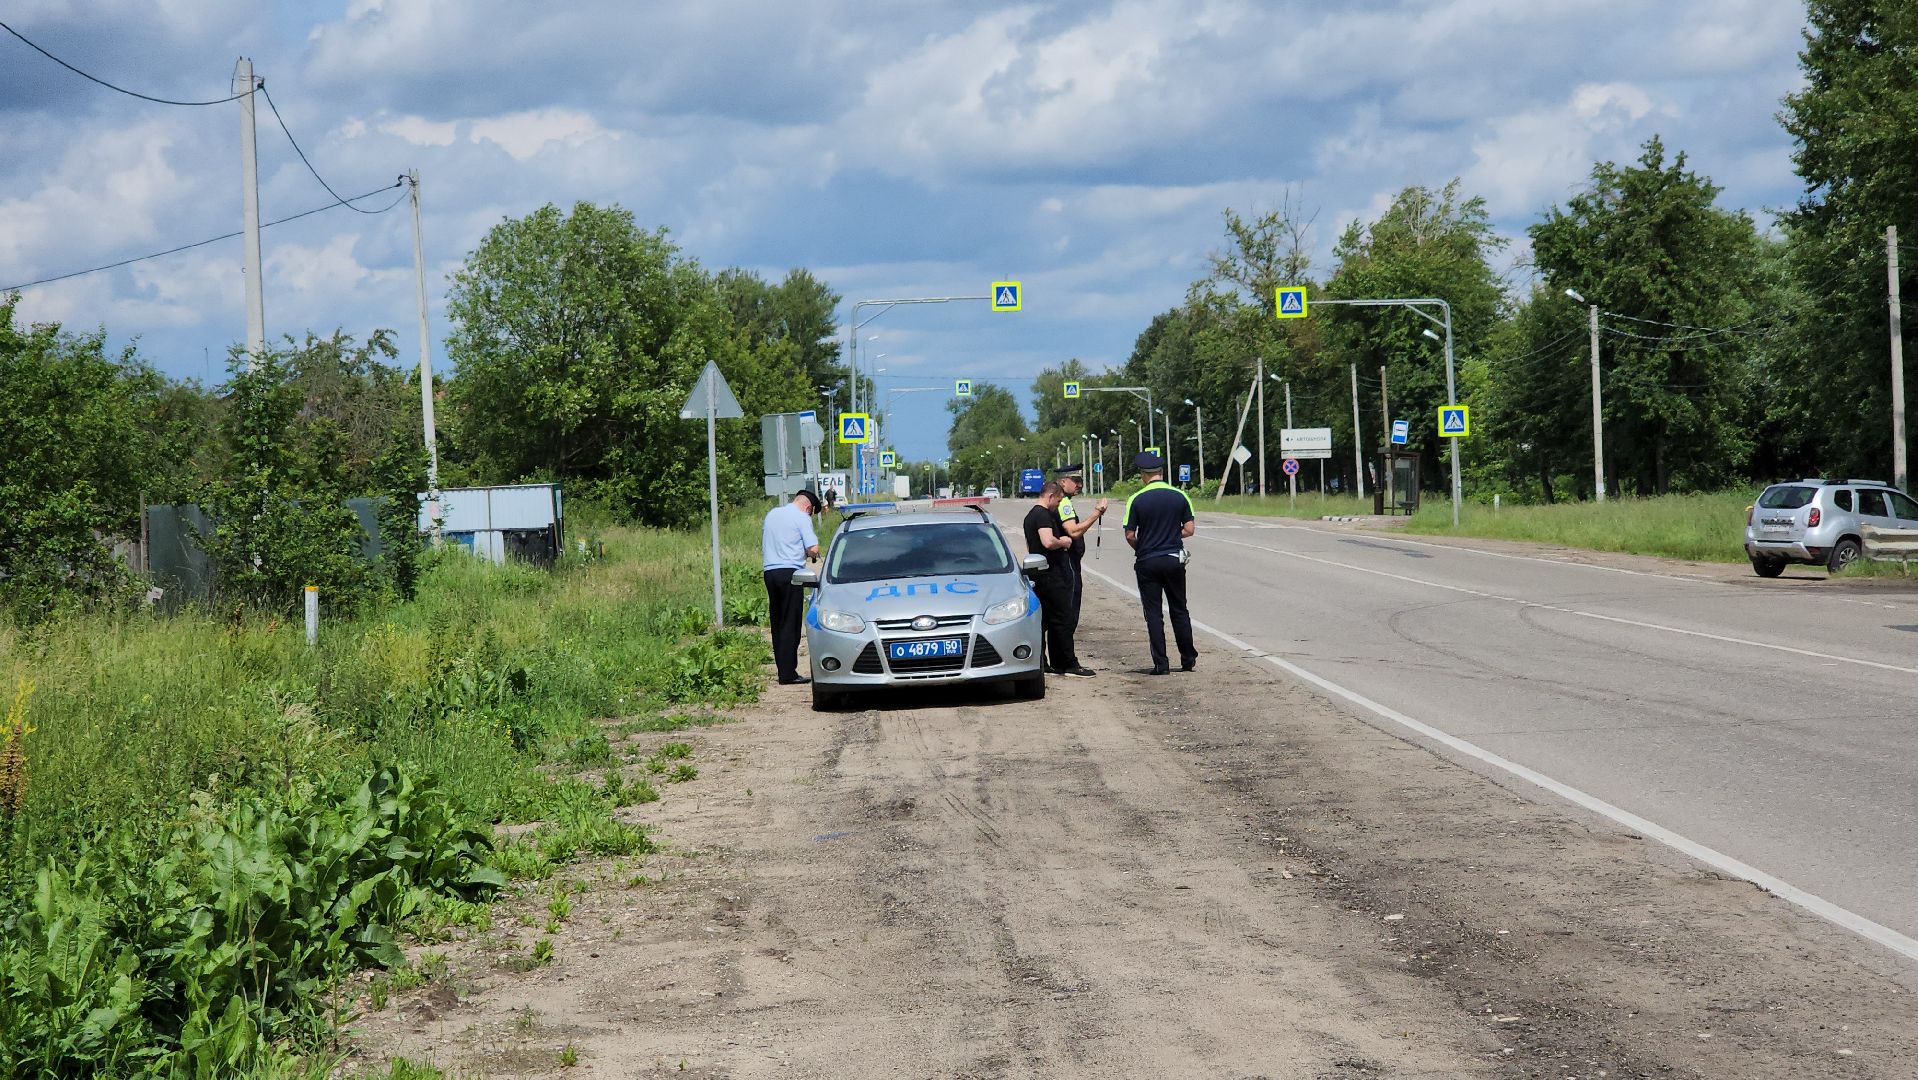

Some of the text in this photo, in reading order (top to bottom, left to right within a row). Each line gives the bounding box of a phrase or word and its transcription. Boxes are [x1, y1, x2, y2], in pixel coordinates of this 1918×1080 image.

[804, 477, 844, 486] БЕЛЬ
[865, 582, 979, 601] ДПС
[909, 642, 938, 656] 4879
[945, 641, 957, 650] 50
